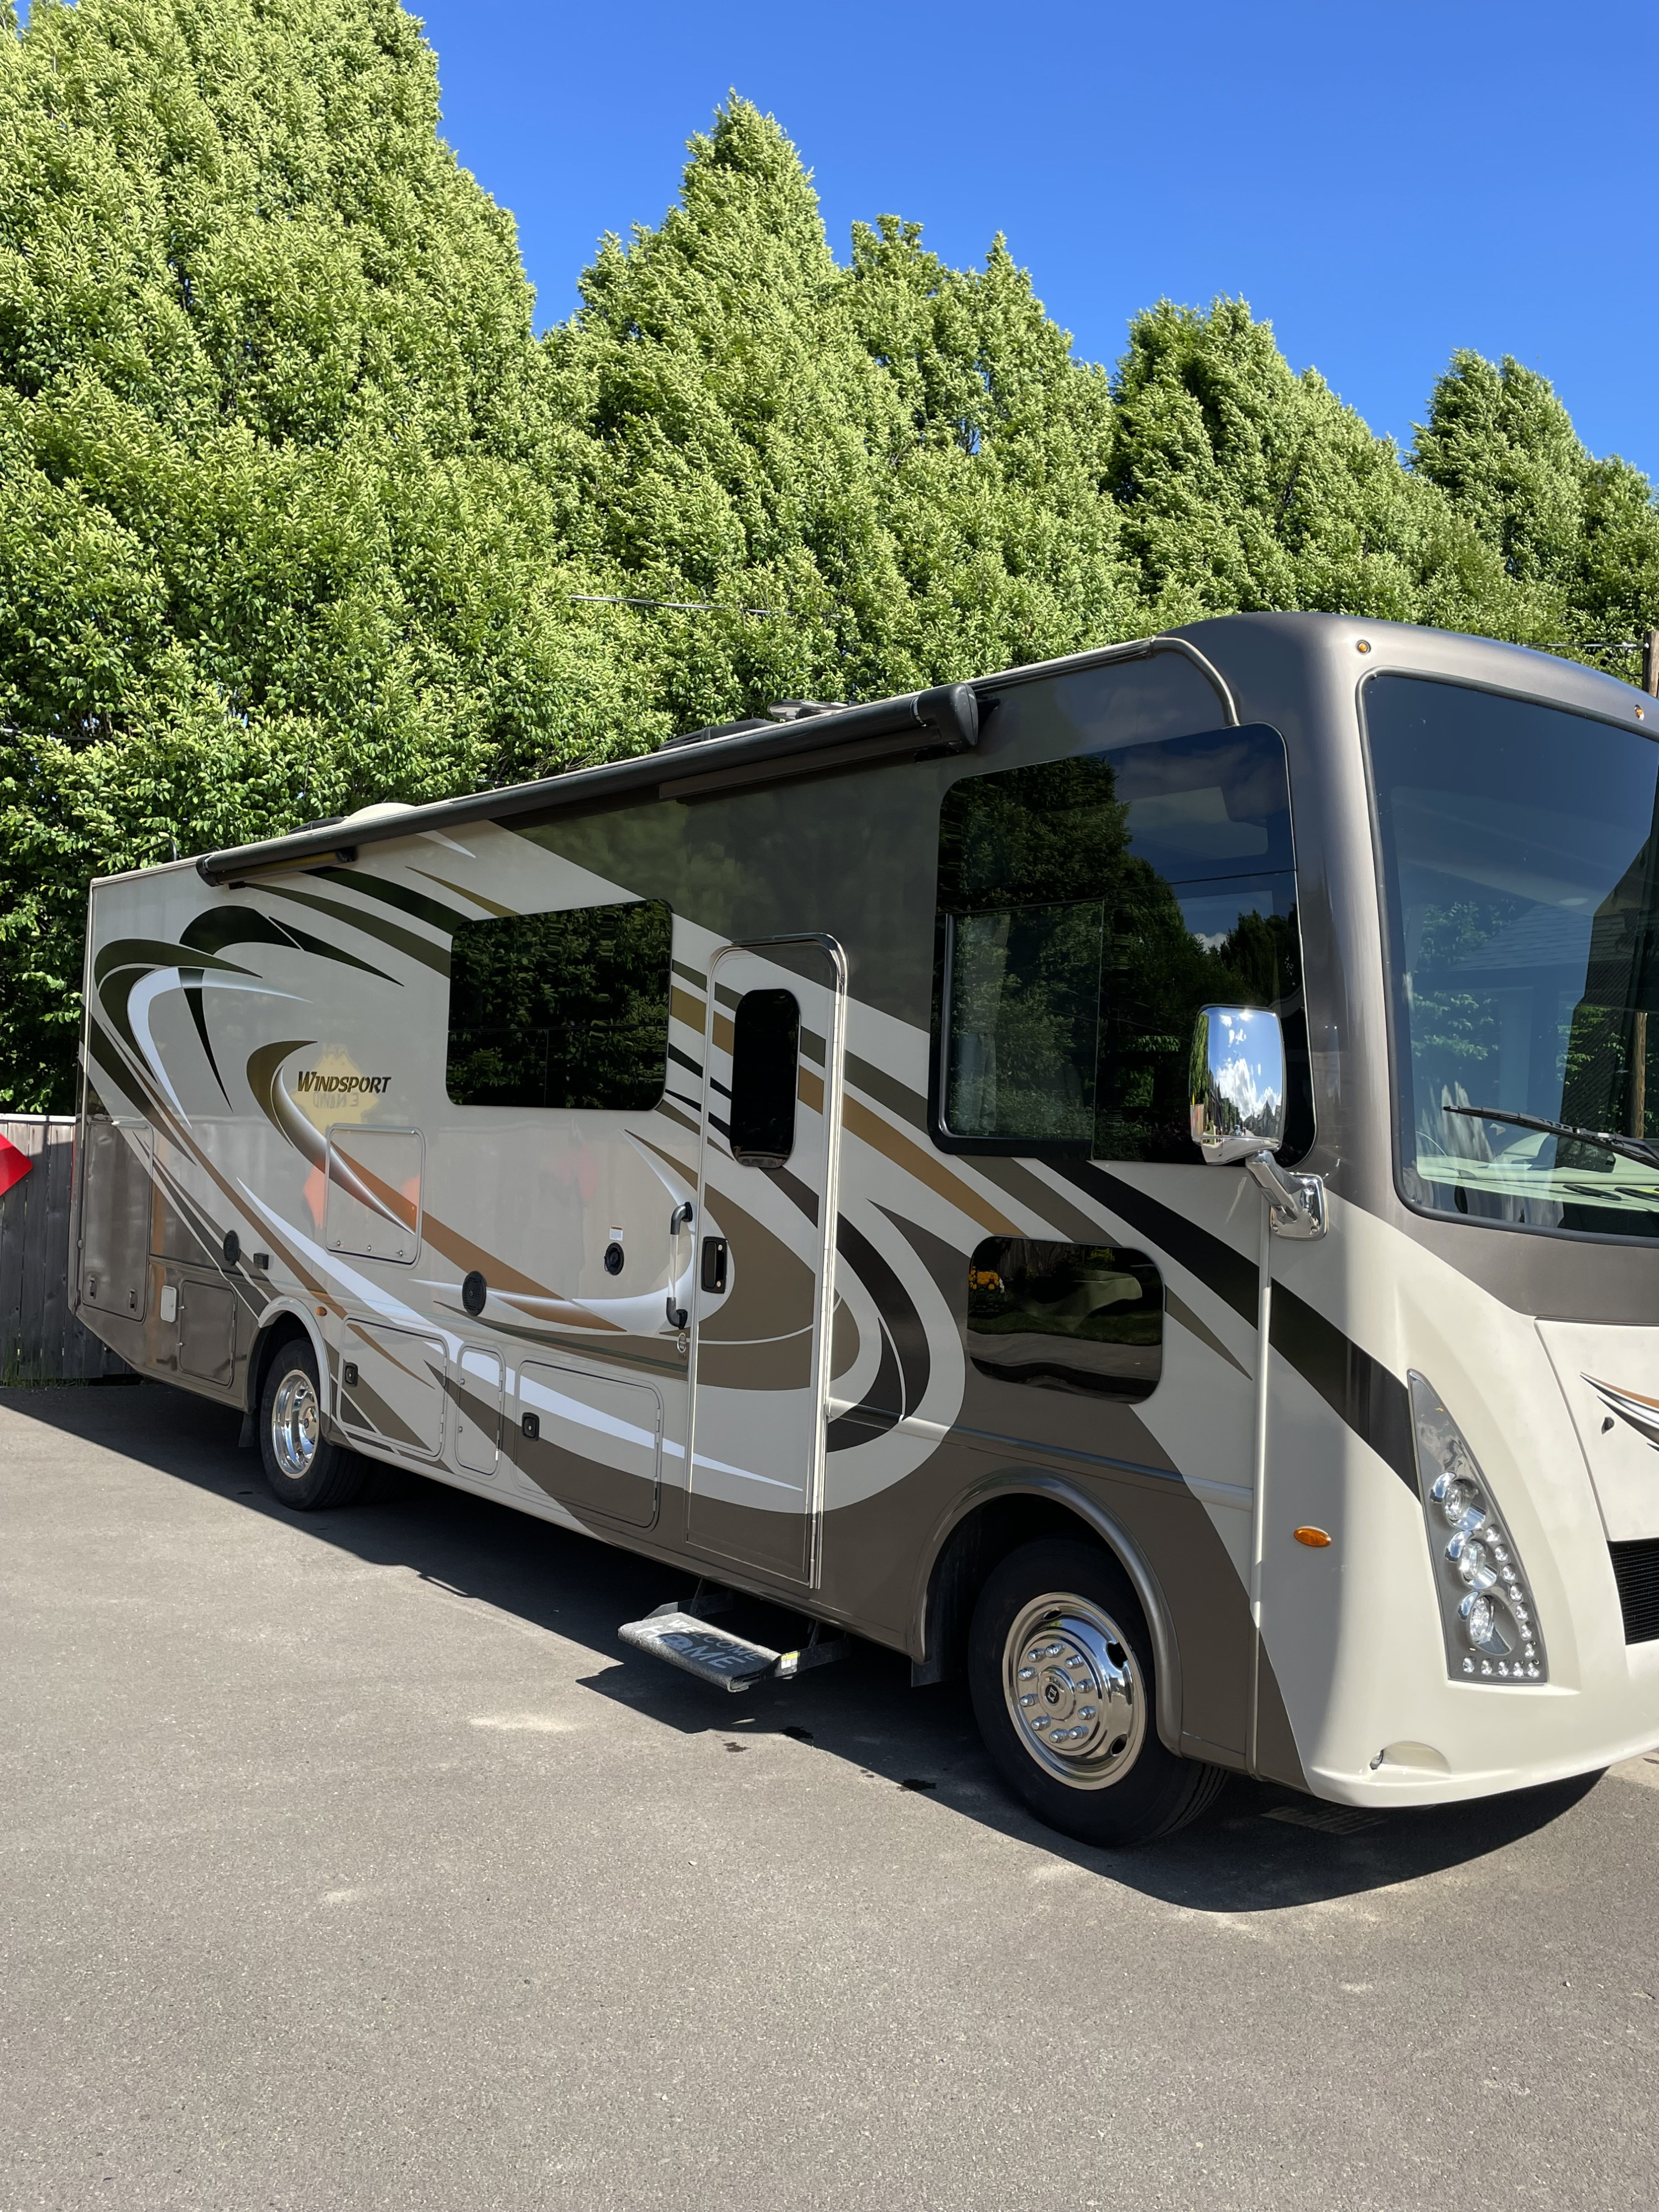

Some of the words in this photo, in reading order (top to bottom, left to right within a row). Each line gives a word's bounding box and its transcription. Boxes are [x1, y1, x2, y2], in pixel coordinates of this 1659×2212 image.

[298, 1071, 392, 1094] WINDSPORT
[635, 1625, 746, 1668] HME
[667, 1619, 766, 1661] WELCOME
